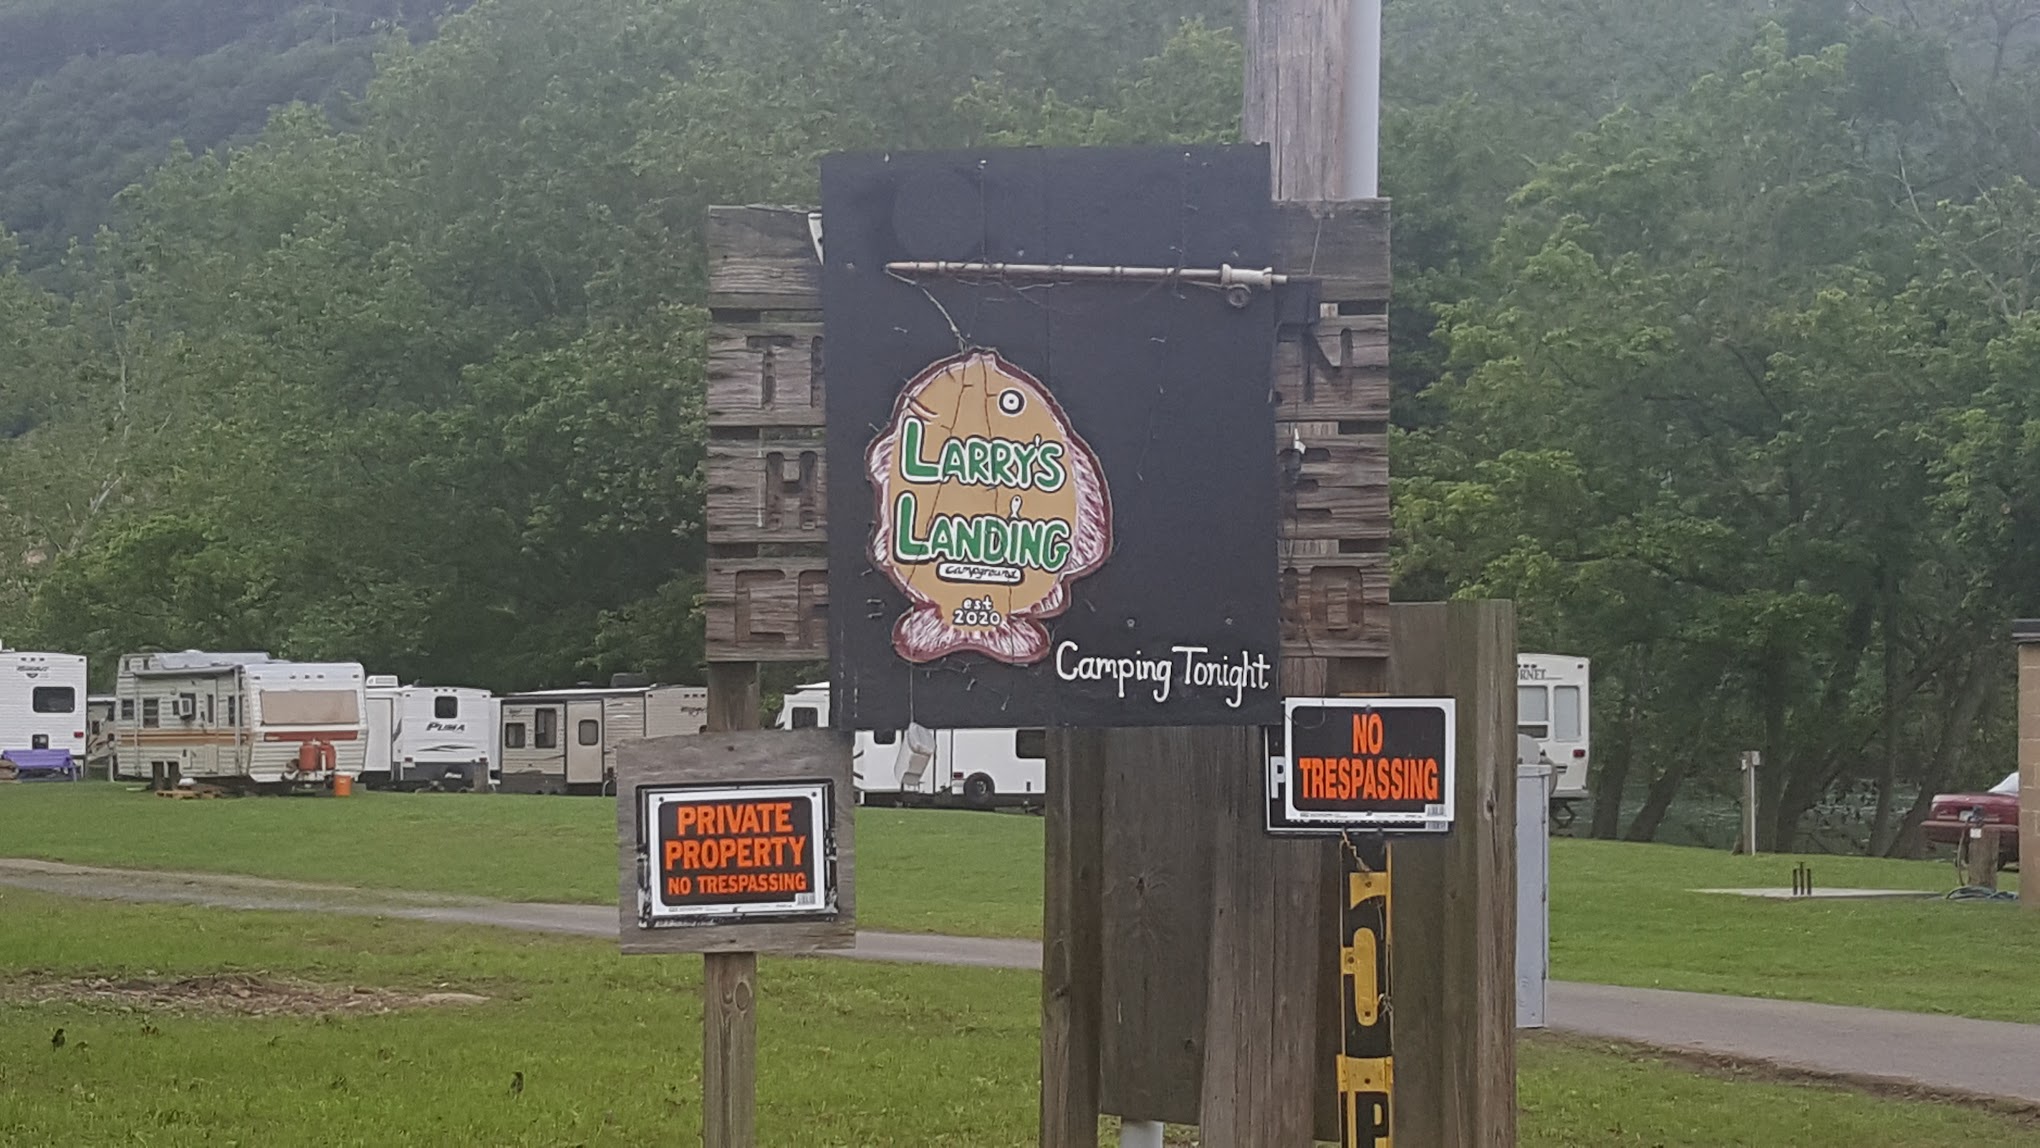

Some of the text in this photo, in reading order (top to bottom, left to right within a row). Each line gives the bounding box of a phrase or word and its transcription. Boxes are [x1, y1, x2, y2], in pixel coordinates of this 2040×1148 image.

[900, 415, 1066, 492] LARRY'S
[895, 493, 1071, 573] LANDING
[953, 609, 1001, 625] 2020
[963, 595, 993, 610] est
[1056, 640, 1271, 708] Camping Tonight
[1519, 669, 1546, 680] RNET
[1352, 713, 1384, 755] NO
[1299, 757, 1440, 800] TRESPASSING
[677, 803, 793, 836] PRIVATE
[664, 836, 806, 870] PROPERTY
[667, 872, 807, 895] NO TRESPASSING
